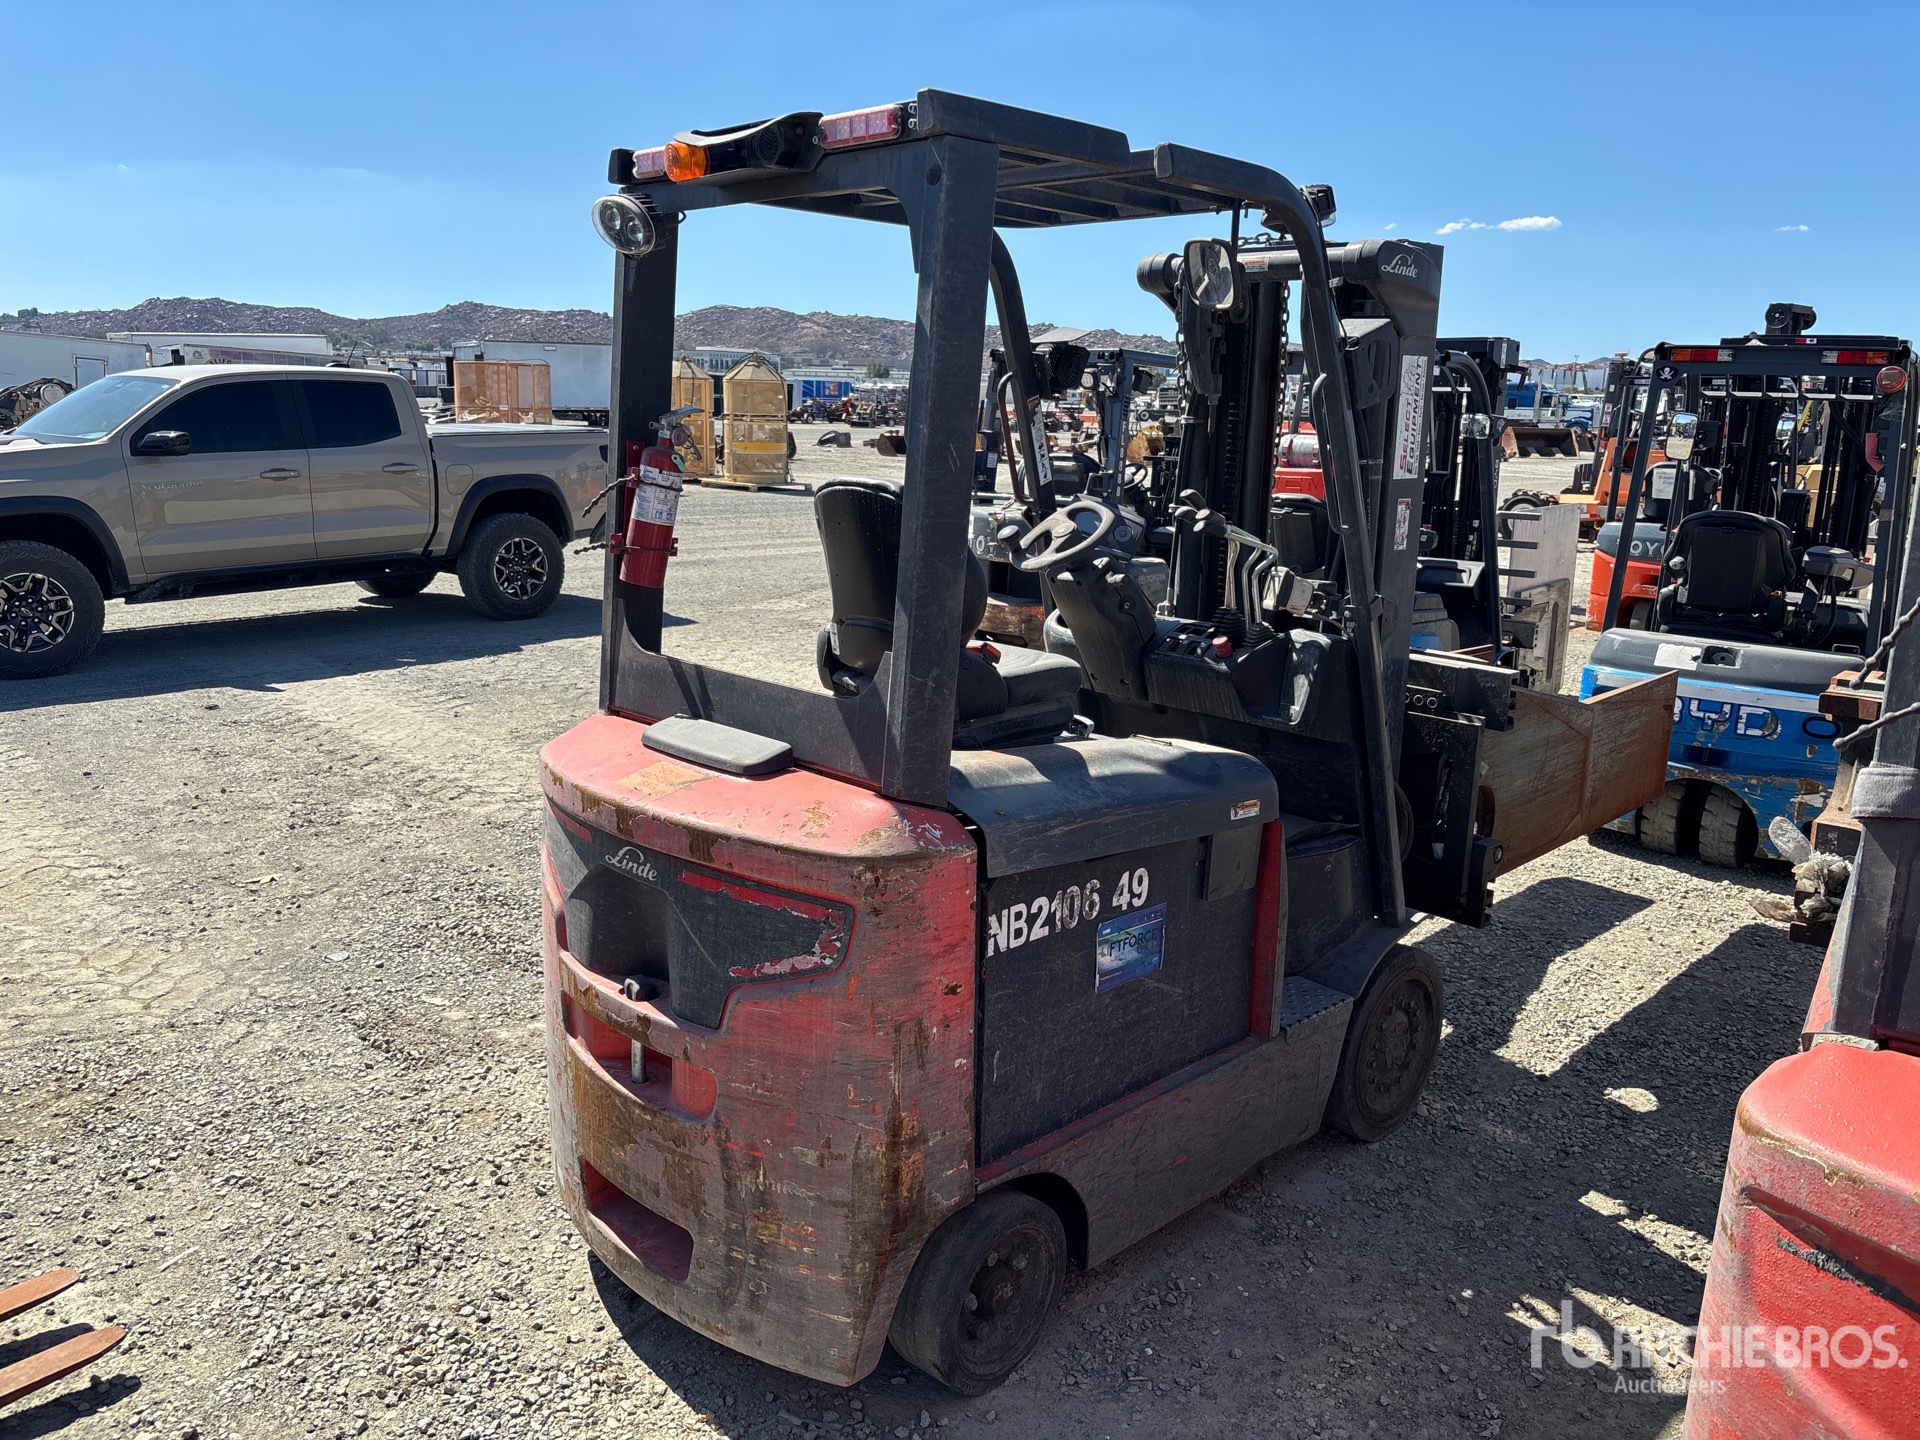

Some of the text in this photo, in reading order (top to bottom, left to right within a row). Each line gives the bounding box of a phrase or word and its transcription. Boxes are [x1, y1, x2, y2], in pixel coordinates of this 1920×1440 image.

[1381, 254, 1418, 278] Linde
[1400, 397, 1412, 470] SELECT
[1406, 360, 1422, 475] EQUIPMENT
[1146, 573, 1166, 583] TOYOTA
[605, 846, 658, 881] Linde
[1111, 867, 1149, 911] 49
[987, 879, 1101, 957] NB2106
[1100, 927, 1158, 958] LIFTFORCE
